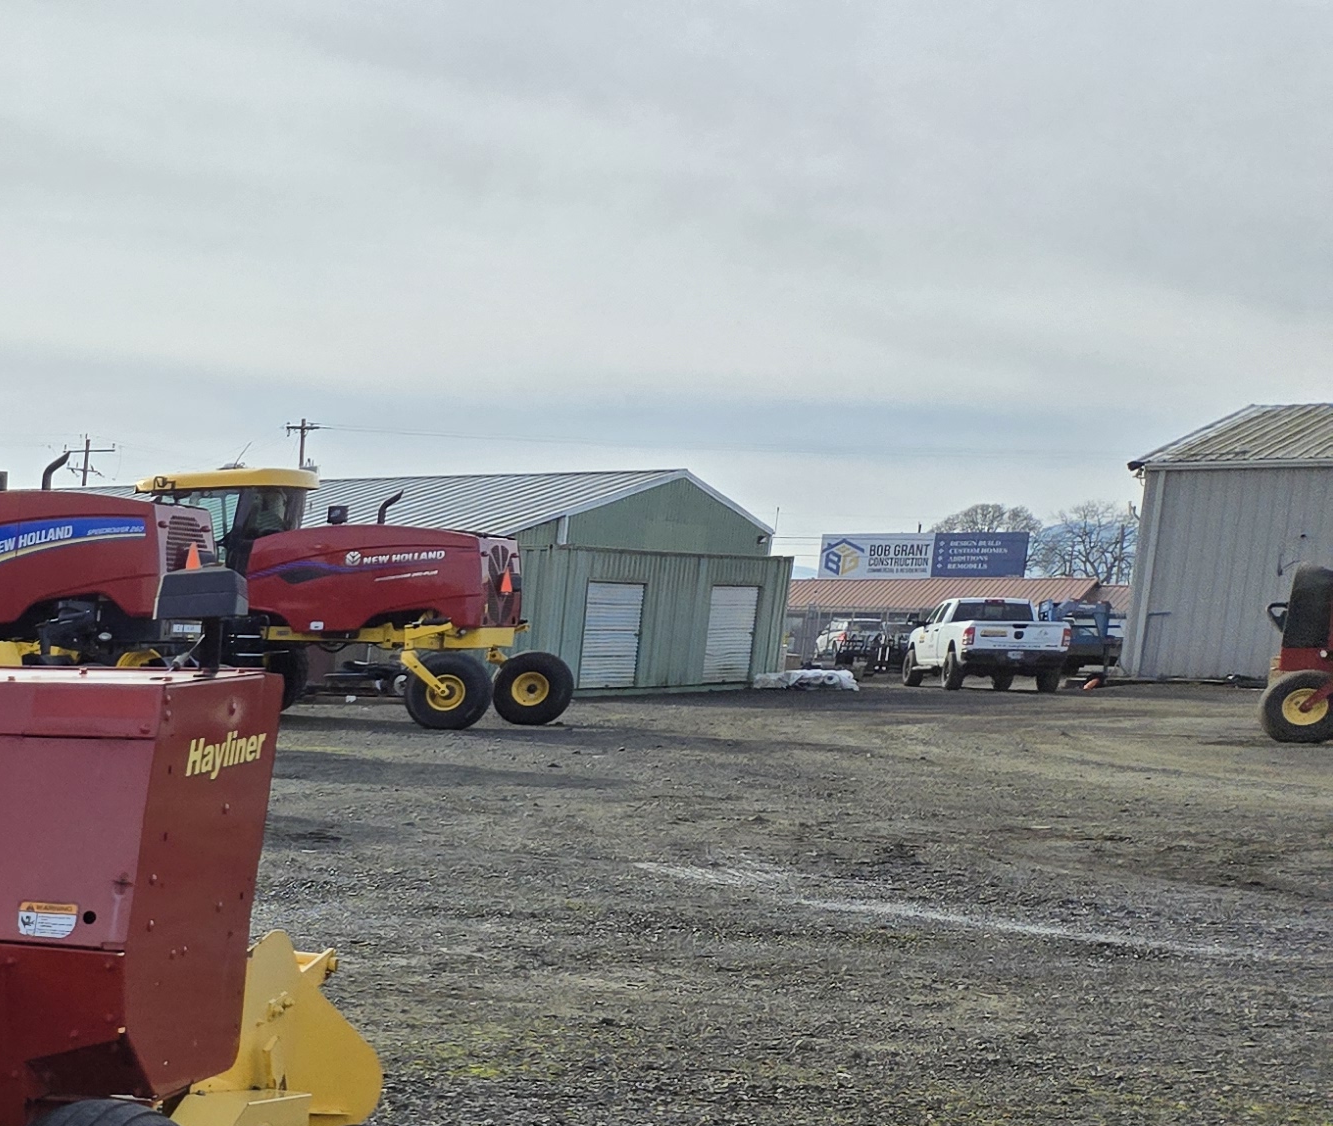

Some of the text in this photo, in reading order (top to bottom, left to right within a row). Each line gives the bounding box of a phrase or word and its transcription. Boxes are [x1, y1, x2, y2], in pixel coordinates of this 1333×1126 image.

[18, 525, 73, 548] HOLLAND
[363, 550, 446, 565] NEW HOLLAND
[869, 544, 930, 557] BOB GRANT
[868, 557, 930, 567] CONSTRUCTION
[185, 730, 267, 780] Hayliner
